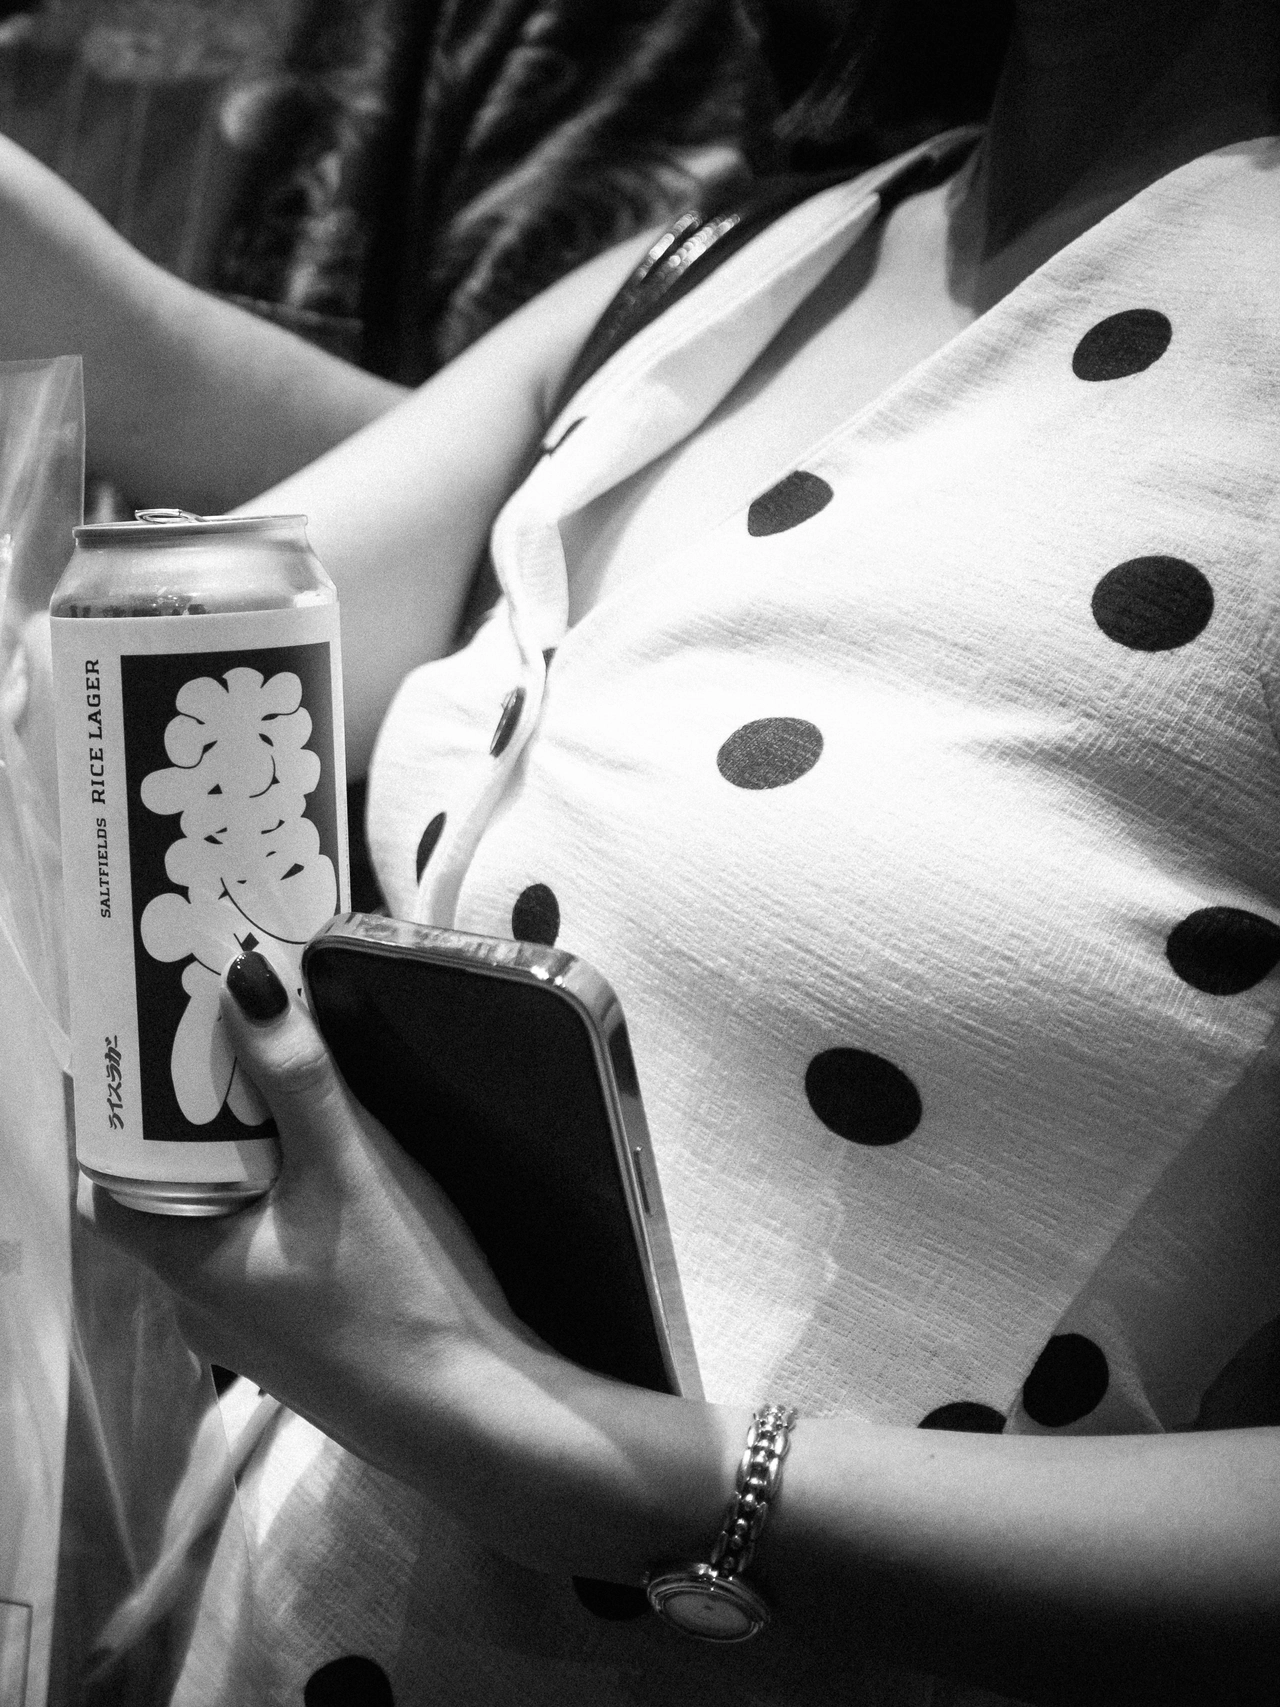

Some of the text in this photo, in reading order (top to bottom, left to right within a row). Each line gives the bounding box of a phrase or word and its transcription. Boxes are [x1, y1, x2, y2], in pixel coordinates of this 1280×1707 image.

[85, 658, 112, 919] SALTFIELDS RICE LAGER
[105, 1034, 124, 1131] ライスラガー
